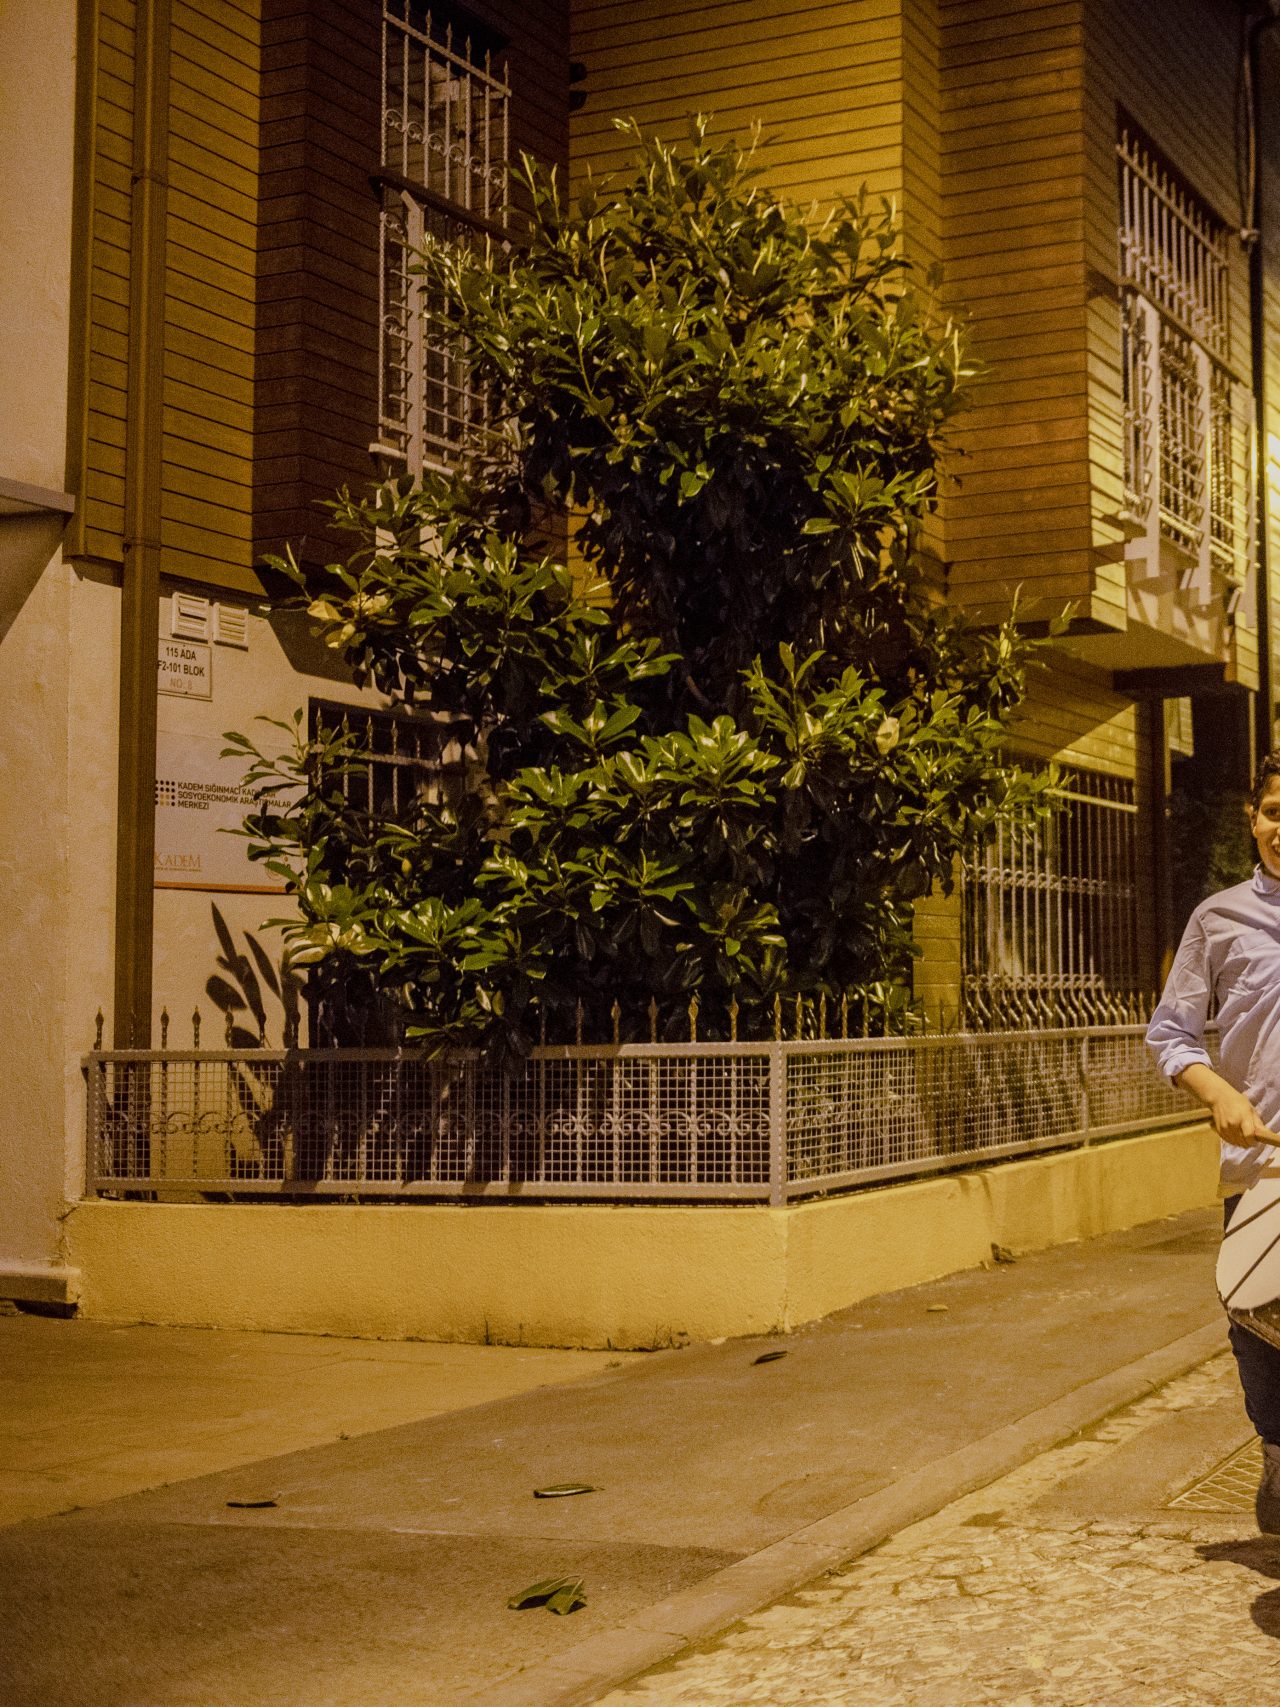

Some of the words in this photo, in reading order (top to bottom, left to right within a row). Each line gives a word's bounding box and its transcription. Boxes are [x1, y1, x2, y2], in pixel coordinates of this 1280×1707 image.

[166, 646, 179, 658] 115
[180, 649, 197, 661] ADA
[183, 664, 205, 677] BLOK
[177, 782, 204, 792] KADEM
